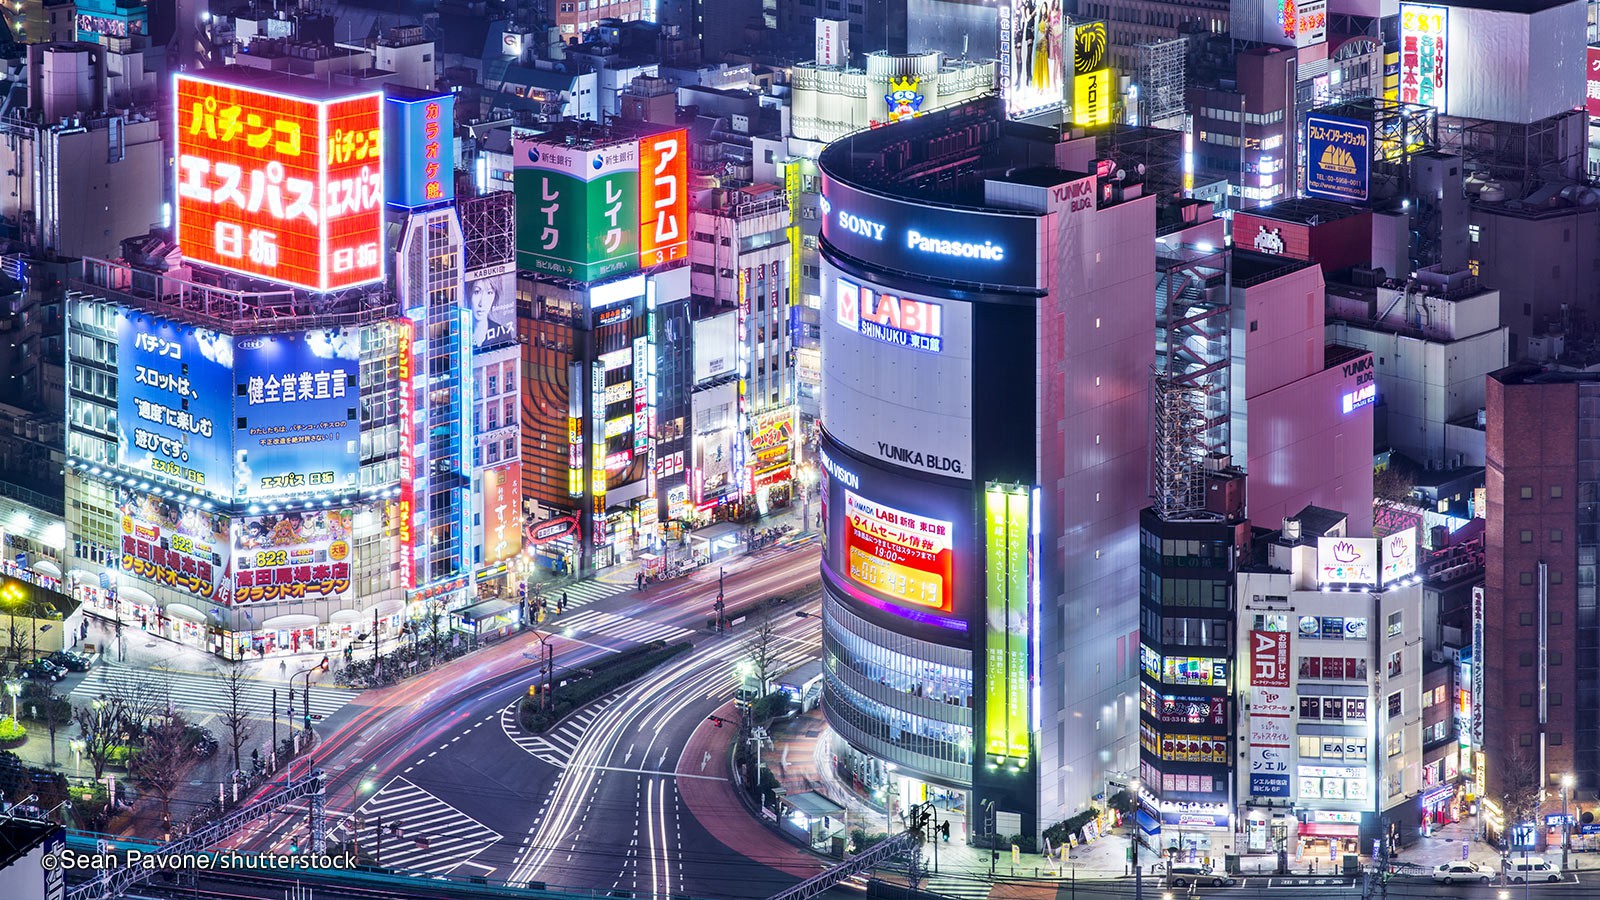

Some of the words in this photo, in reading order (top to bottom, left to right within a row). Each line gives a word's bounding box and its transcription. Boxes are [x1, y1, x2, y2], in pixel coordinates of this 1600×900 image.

[190, 95, 301, 156] パチンコ
[328, 128, 381, 165] パチンコ
[425, 102, 444, 200] カラオケ館
[541, 151, 572, 168] 新生銀行
[605, 151, 634, 166] 新生銀行
[179, 154, 318, 226] エスパス
[327, 165, 382, 218] エスパス
[653, 138, 680, 244] アコム
[1053, 181, 1092, 203] YUNIKA
[540, 177, 559, 250] レイク
[604, 179, 623, 254] レイク
[839, 211, 885, 241] SONY
[908, 230, 1004, 261] Panasonic
[861, 286, 941, 336] LABI
[135, 332, 182, 360] パチンコ
[399, 325, 409, 379] パチンコ
[861, 320, 907, 346] SHINJUKU
[911, 334, 941, 352] 東口館
[135, 365, 199, 400] スロットは、
[1342, 356, 1374, 378] YUNIKA
[247, 369, 347, 406] 健全営業宣言
[134, 428, 189, 462] 遊びです。
[878, 442, 923, 467] YUNIKA
[926, 454, 964, 474] BLDG.
[152, 458, 181, 476] エスパス
[657, 455, 682, 474] アコム
[834, 463, 859, 489] VISION
[261, 474, 305, 489] エスパス
[854, 514, 934, 550] タイムセール情報
[876, 508, 898, 524] LABI
[900, 516, 915, 529] 新宿
[920, 521, 945, 536] 東口館
[237, 562, 349, 587] 高田馬場本店
[256, 550, 287, 567] 823
[122, 554, 213, 598] グランドオープン
[235, 580, 350, 603] グランドオープン
[1256, 633, 1275, 679] AIR
[1324, 744, 1366, 753] EAST
[1253, 761, 1287, 771] シエル
